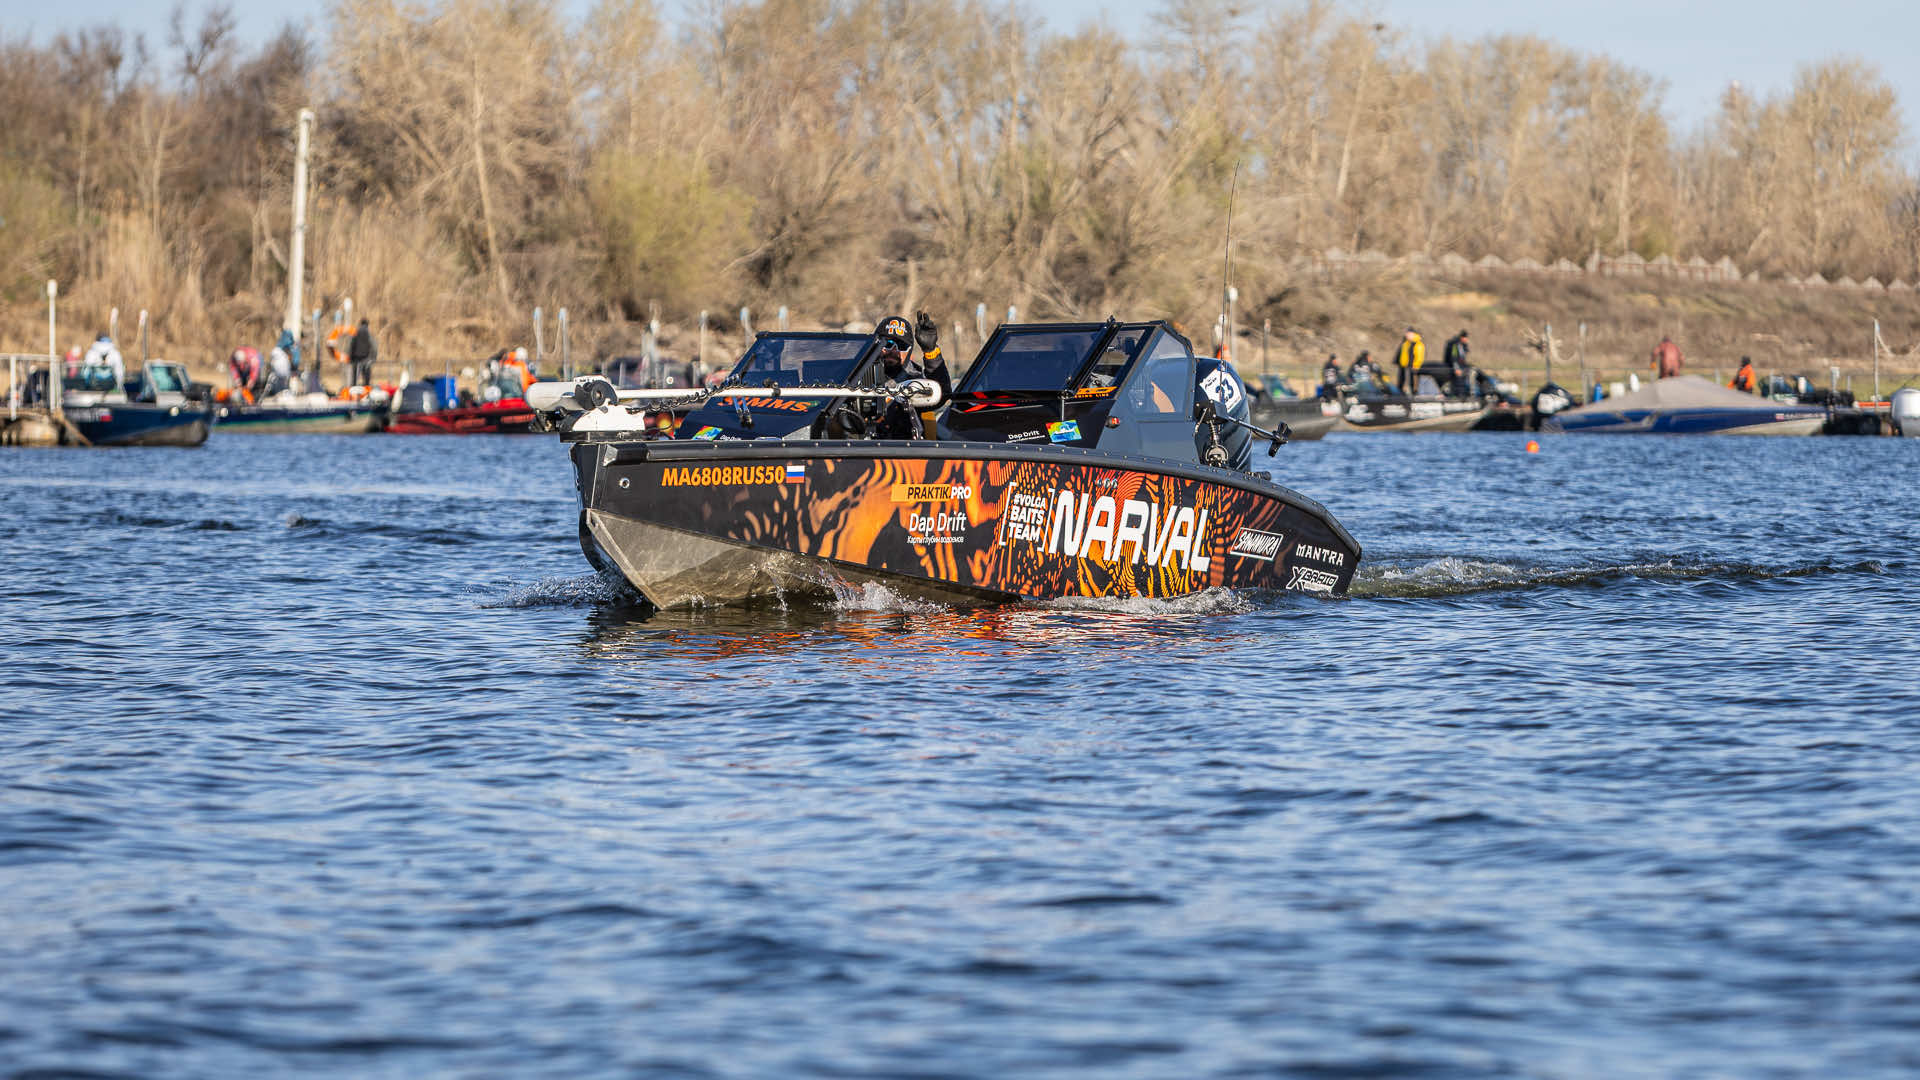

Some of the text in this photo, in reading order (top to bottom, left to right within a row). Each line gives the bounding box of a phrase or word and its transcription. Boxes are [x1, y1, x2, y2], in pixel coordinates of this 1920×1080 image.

[661, 465, 785, 487] MA6808RUS50
[1013, 493, 1046, 509] #VOLGA
[909, 511, 967, 537] Dap Drift
[1010, 505, 1045, 525] BAITS
[1008, 522, 1041, 542] TEAM
[1048, 489, 1211, 572] NARVAL
[1296, 543, 1344, 566] MANTRA
